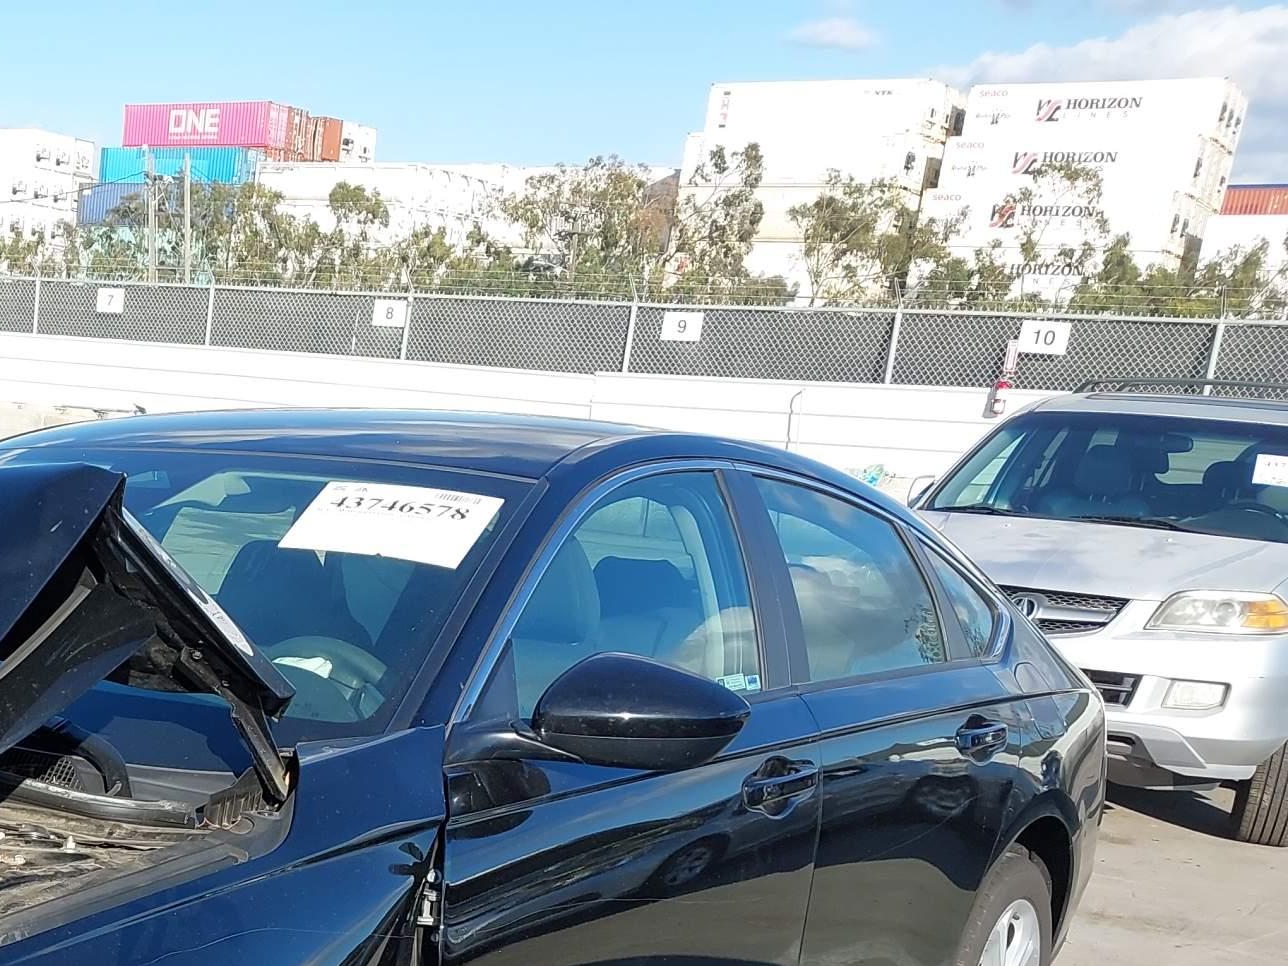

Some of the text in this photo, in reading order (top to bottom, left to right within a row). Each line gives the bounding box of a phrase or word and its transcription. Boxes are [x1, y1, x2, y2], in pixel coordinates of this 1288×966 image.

[1066, 97, 1144, 110] HORIZON
[168, 108, 220, 133] ONE
[1042, 151, 1119, 163] HORIZON
[1020, 205, 1098, 218] HORIZON
[1010, 263, 1085, 277] HORIZON
[107, 294, 114, 306] 7
[385, 307, 394, 320] 8
[677, 319, 687, 333] 9
[1033, 330, 1056, 346] 10
[330, 496, 471, 521] 43746578
